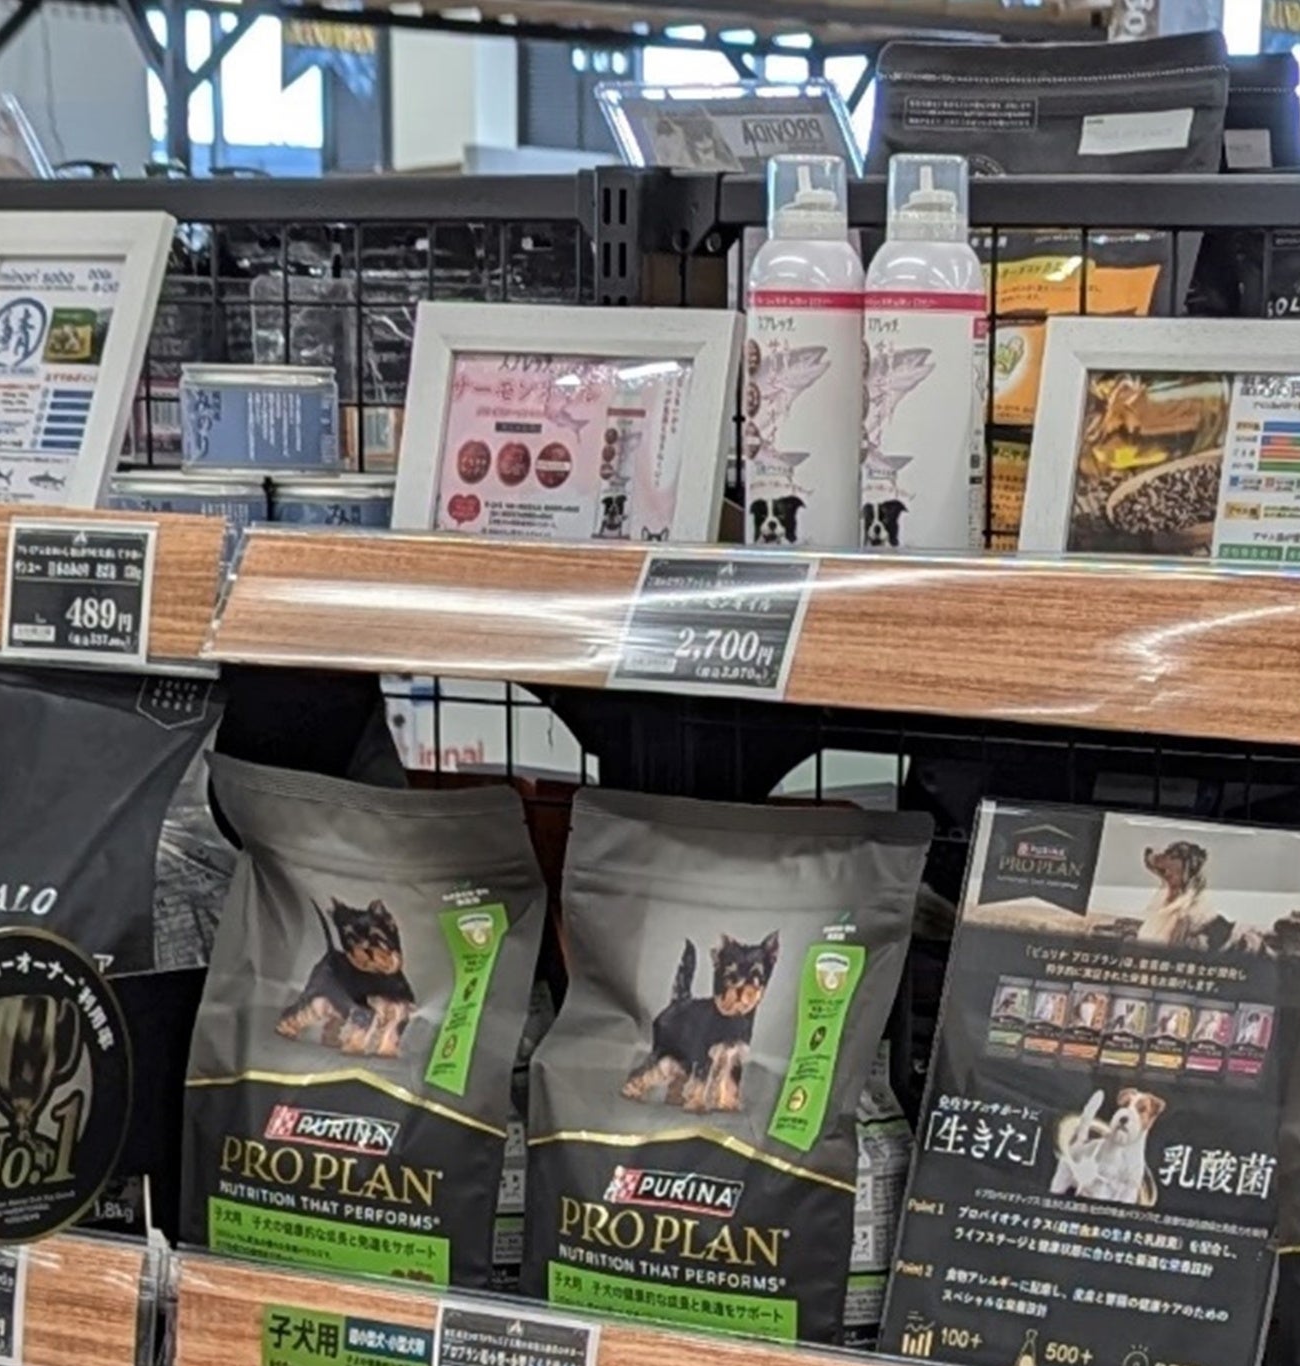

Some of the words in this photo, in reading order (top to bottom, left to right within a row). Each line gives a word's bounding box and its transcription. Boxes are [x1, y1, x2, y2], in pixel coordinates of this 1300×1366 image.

[65, 598, 133, 633] 489円
[674, 626, 775, 667] 2,700円
[297, 1114, 390, 1150] PURINA
[924, 1112, 1041, 1167] 「生きた」
[220, 1136, 304, 1184] PRO
[313, 1151, 435, 1205] PLAN
[637, 1172, 740, 1212] PURINA
[1159, 1144, 1278, 1199] 乳酸菌
[219, 1181, 295, 1211] NUTRITION
[301, 1197, 340, 1217] THAT
[345, 1203, 435, 1230] PERFORMS
[559, 1196, 652, 1246] PRO
[652, 1212, 780, 1267] PLAN
[558, 1244, 634, 1274] NUTRITION
[641, 1259, 681, 1278] THAT
[686, 1267, 776, 1293] PERFORMS
[268, 1308, 340, 1360] 子犬用
[1044, 1341, 1094, 1366] 500+
